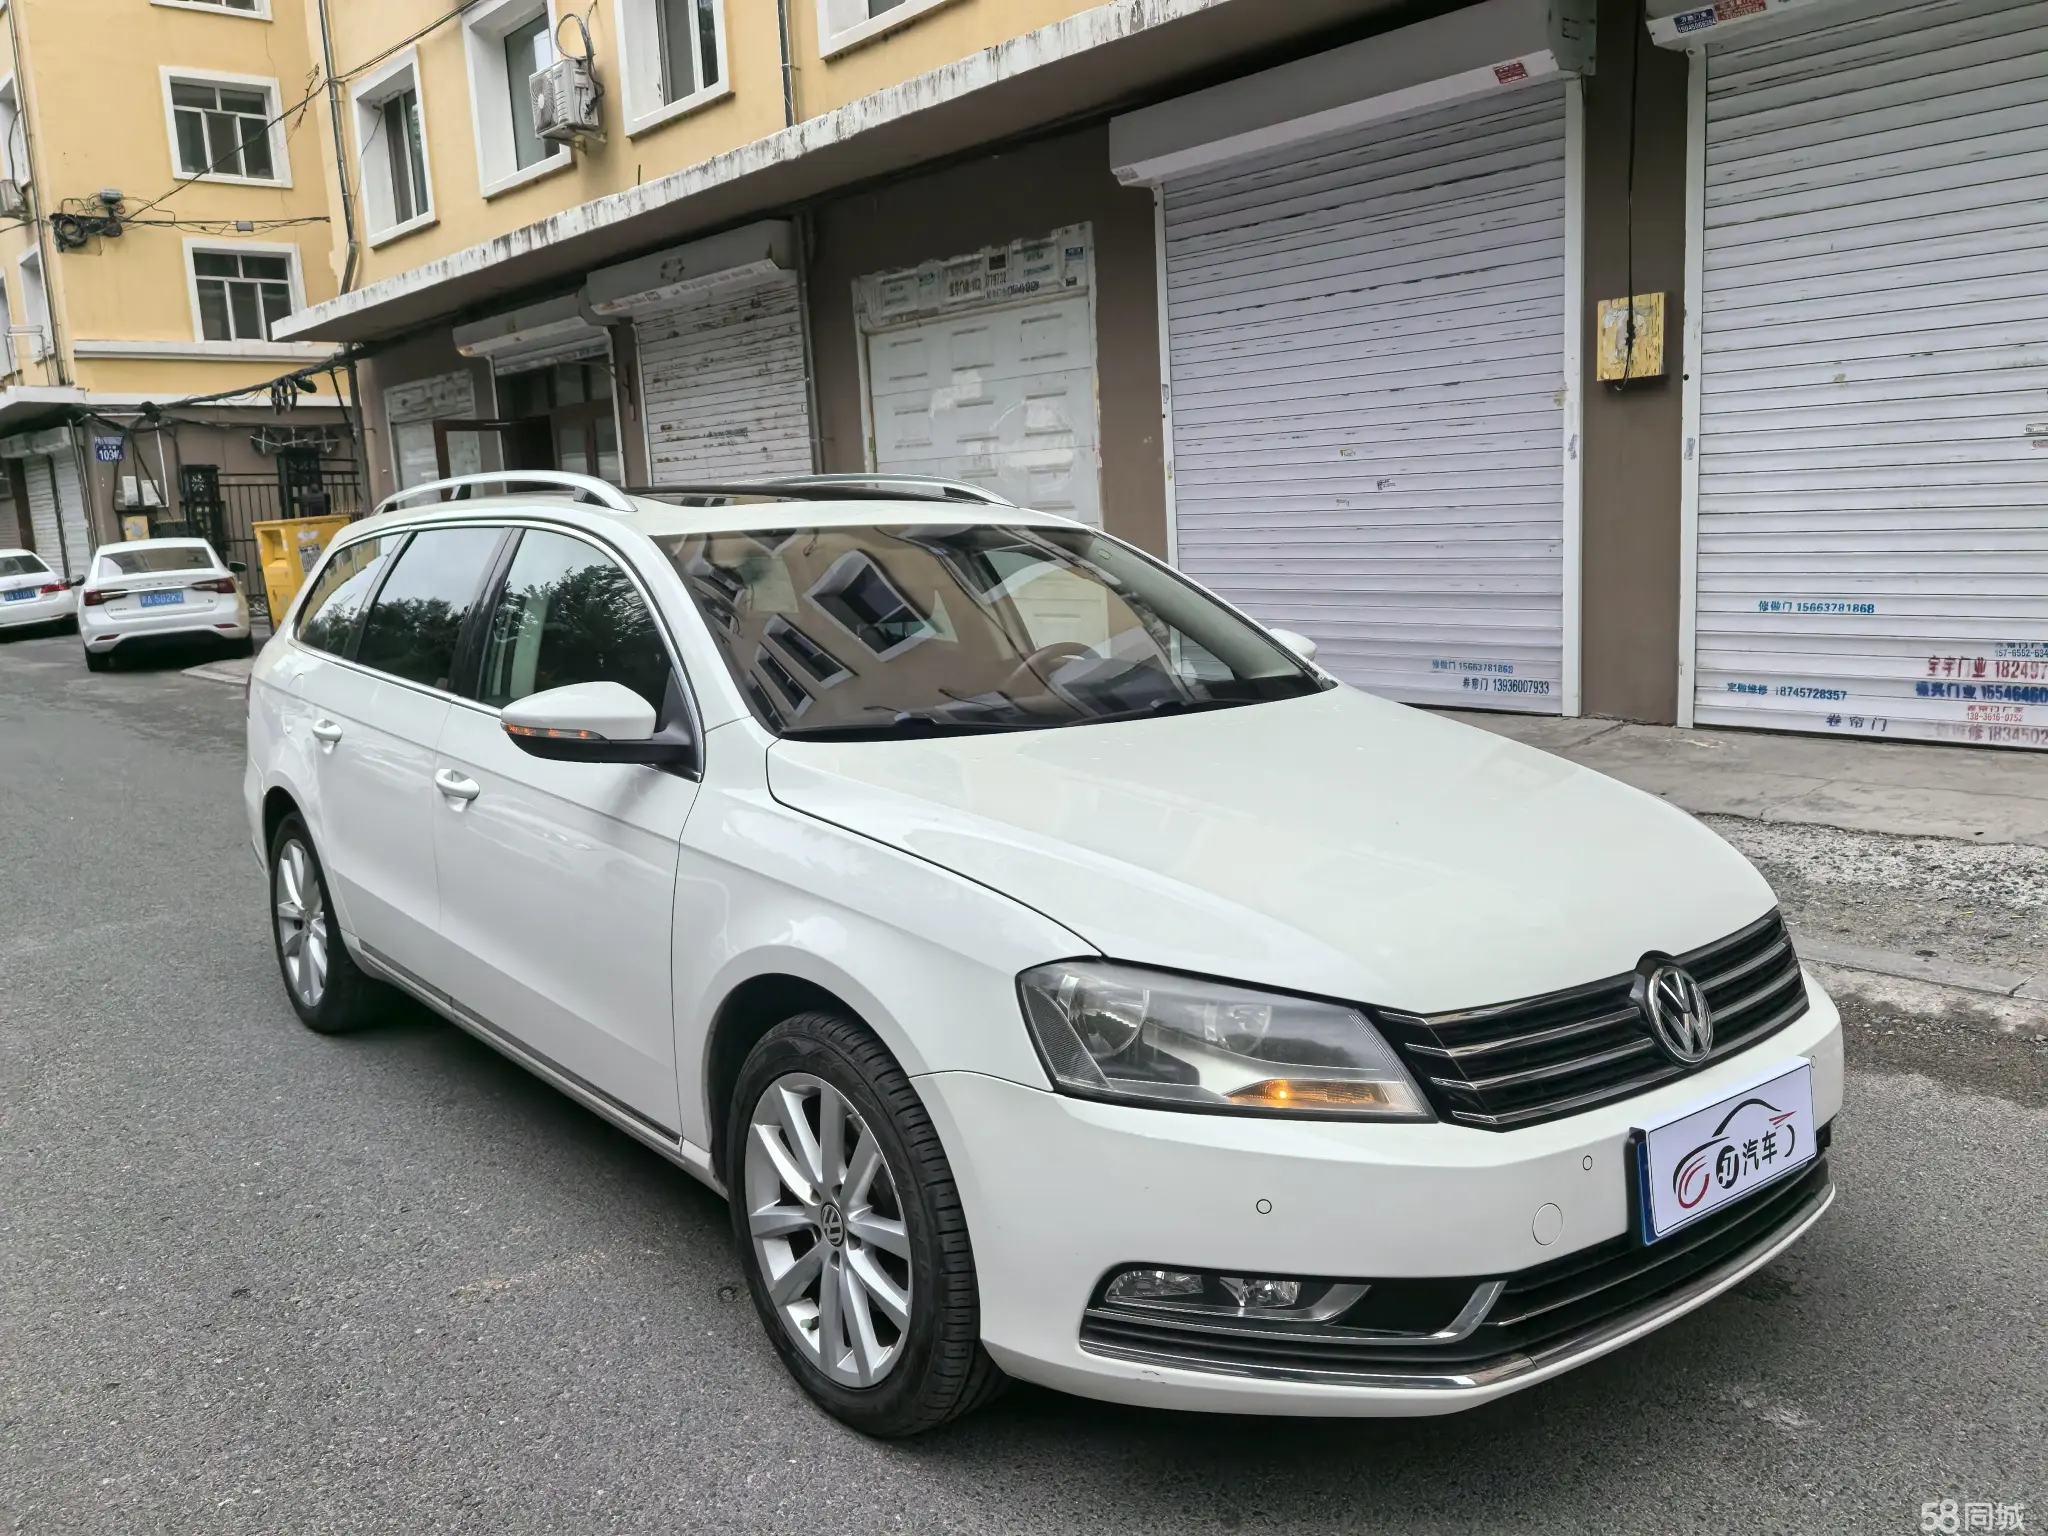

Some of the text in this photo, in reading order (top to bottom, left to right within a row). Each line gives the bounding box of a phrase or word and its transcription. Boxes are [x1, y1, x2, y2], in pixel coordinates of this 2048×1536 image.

[1796, 602, 1875, 614] 15663781868
[1493, 678, 1550, 695] 13936007933
[1775, 686, 1848, 701] 18745728357
[1826, 713, 1888, 732] 卷帘门
